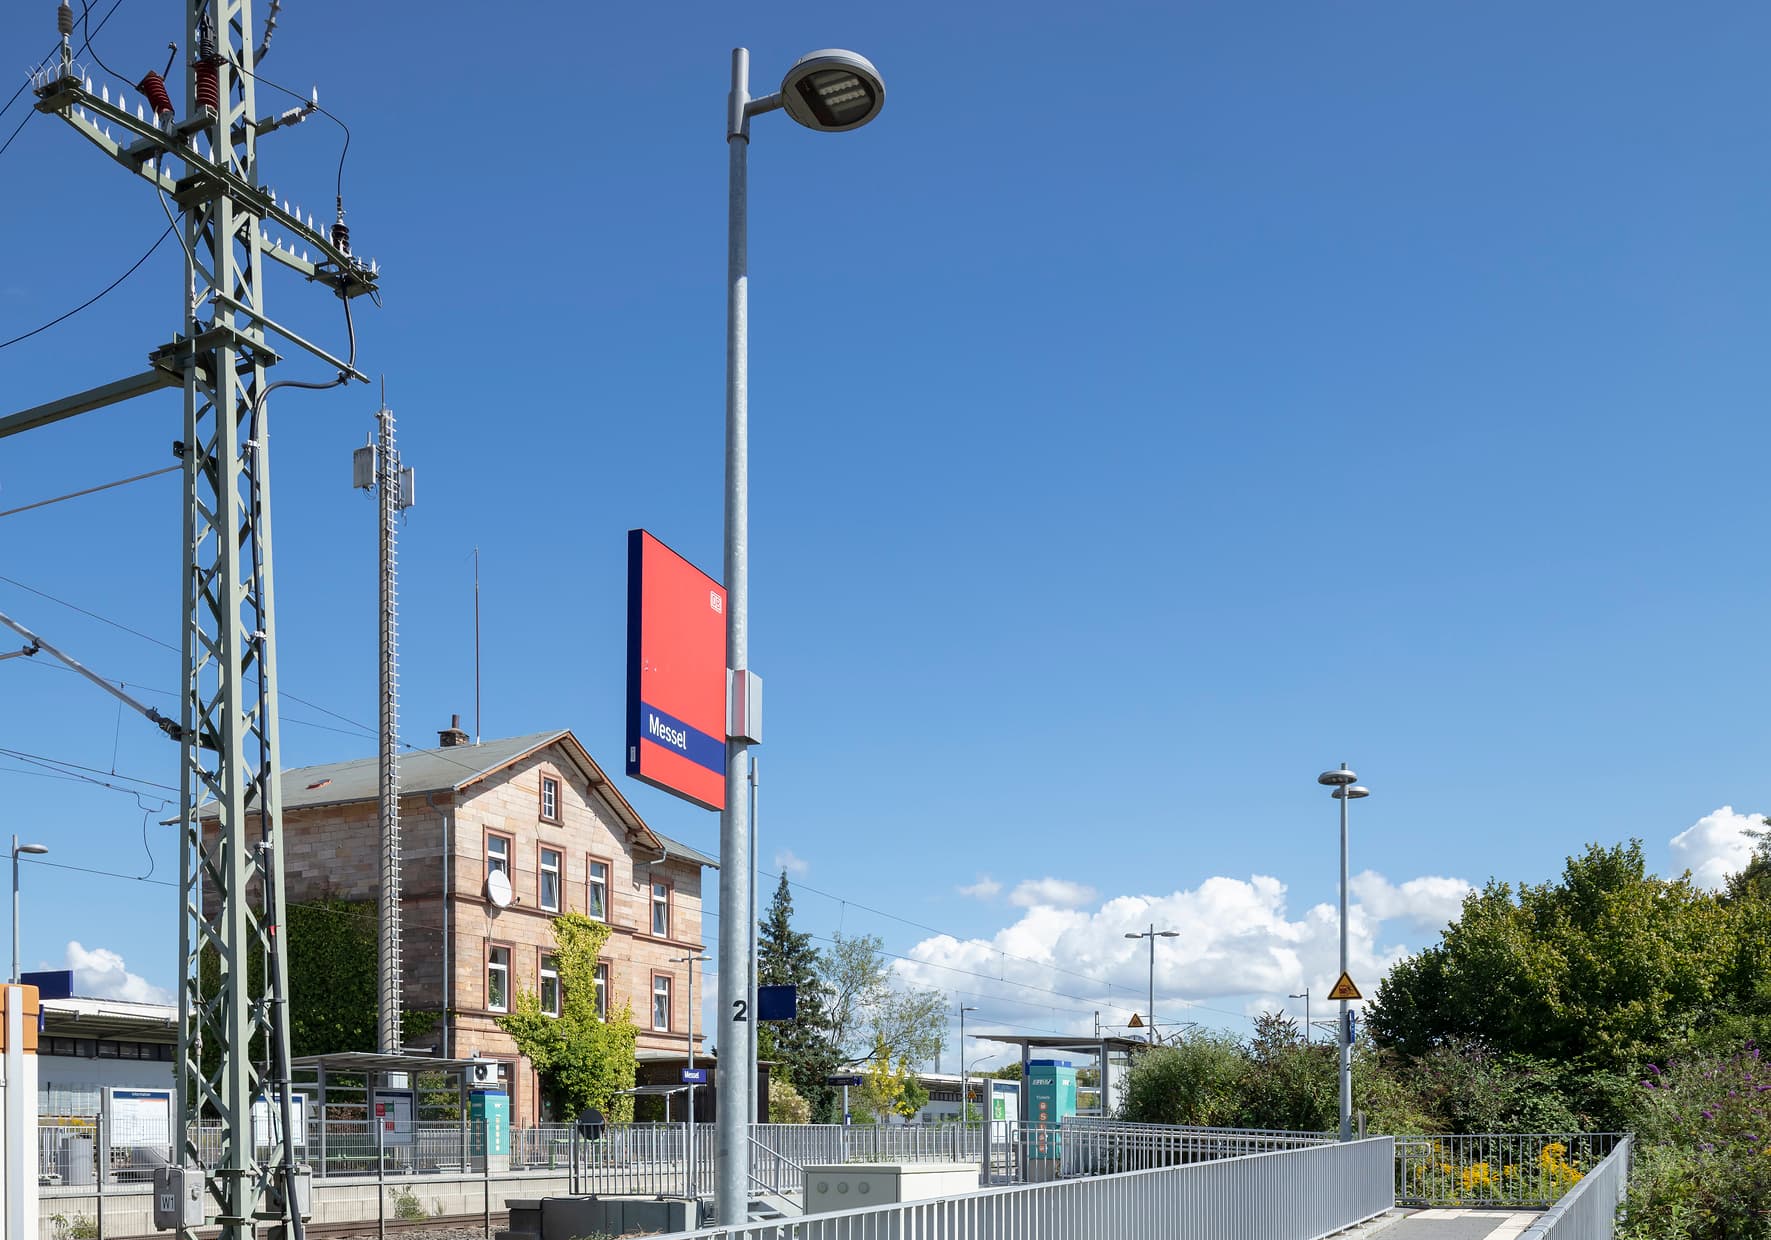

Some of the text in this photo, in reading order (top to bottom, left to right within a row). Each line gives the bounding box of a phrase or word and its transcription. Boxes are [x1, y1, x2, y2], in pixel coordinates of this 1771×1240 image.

[649, 713, 687, 750] Messel
[733, 1000, 746, 1021] 2
[162, 1196, 174, 1209] W1
